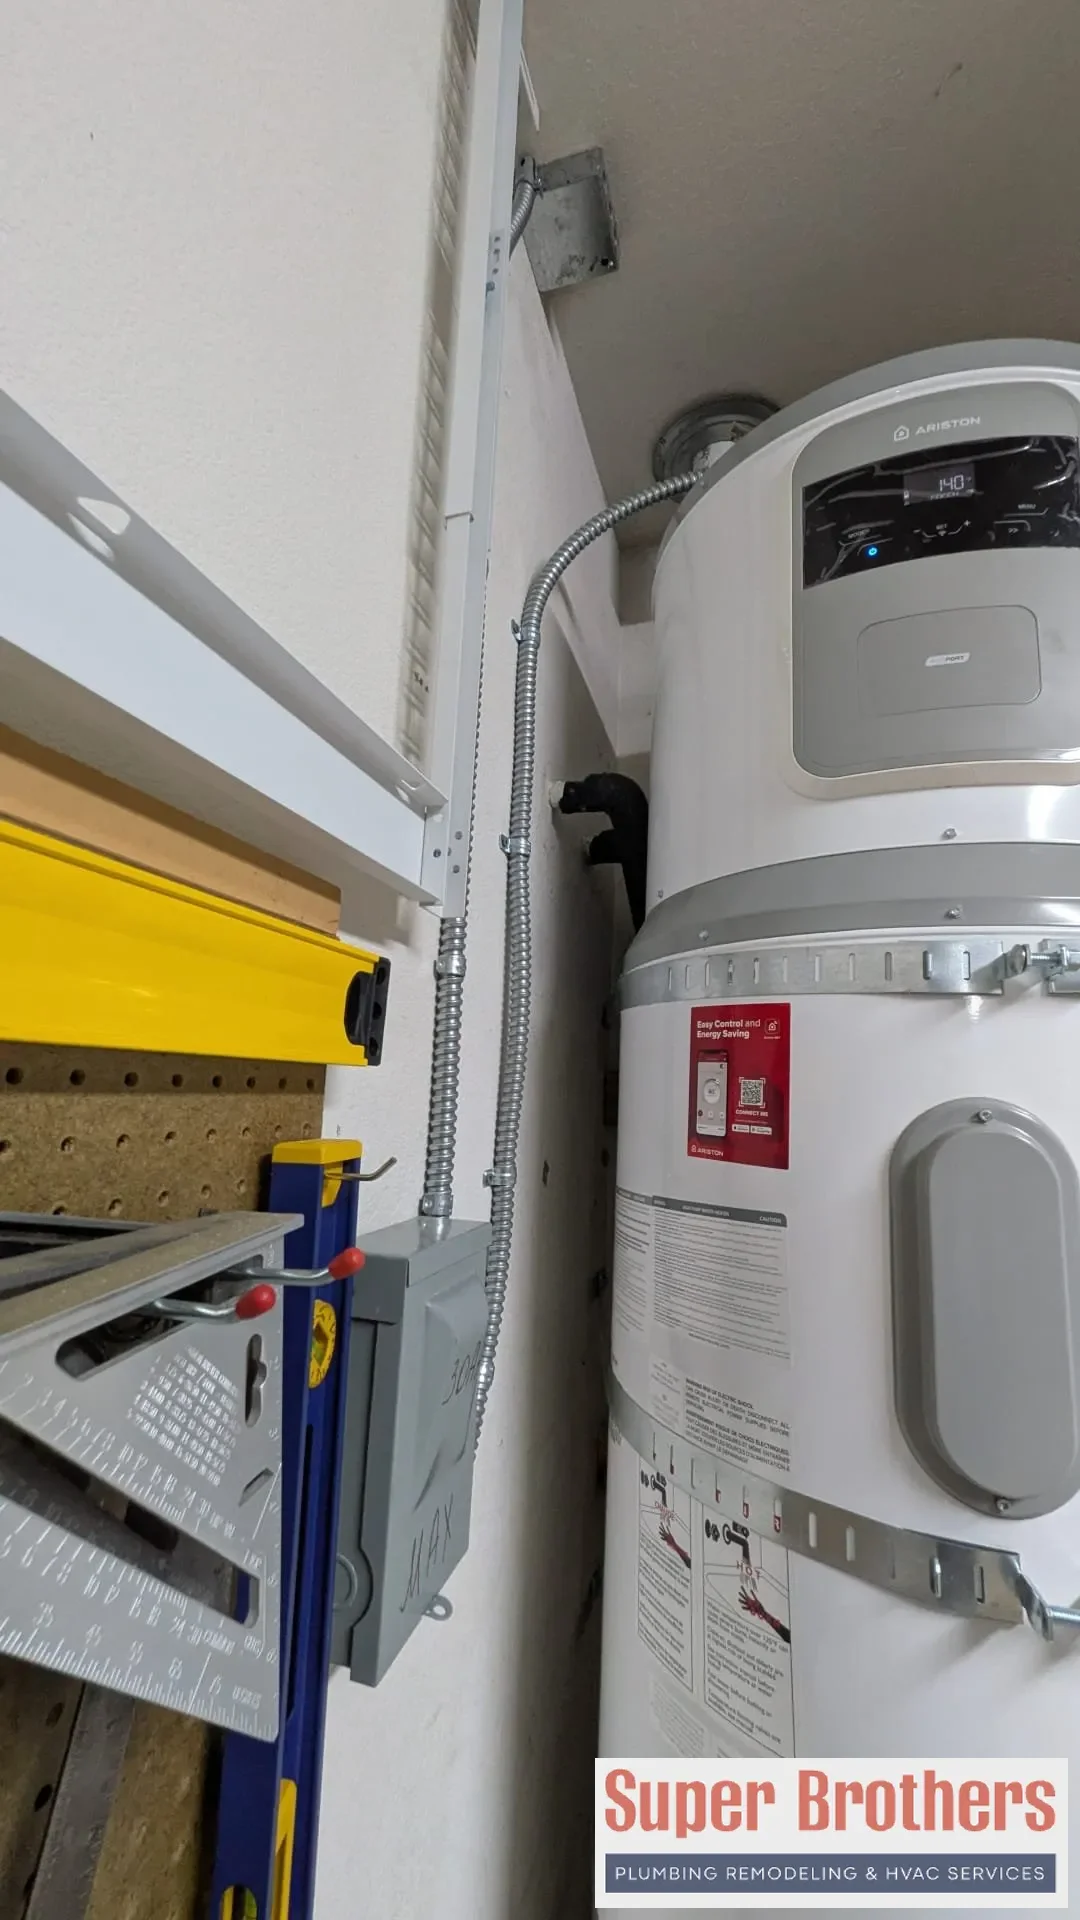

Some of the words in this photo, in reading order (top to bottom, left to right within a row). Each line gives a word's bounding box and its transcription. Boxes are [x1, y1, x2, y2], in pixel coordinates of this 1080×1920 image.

[915, 416, 980, 435] ARISTON
[939, 474, 964, 492] 140
[697, 1020, 713, 1030] Easy
[714, 1019, 743, 1028] Control
[744, 1019, 761, 1028] and
[697, 1030, 721, 1040] Energy
[722, 1029, 750, 1039] Saving
[697, 1147, 724, 1157] ARISTON
